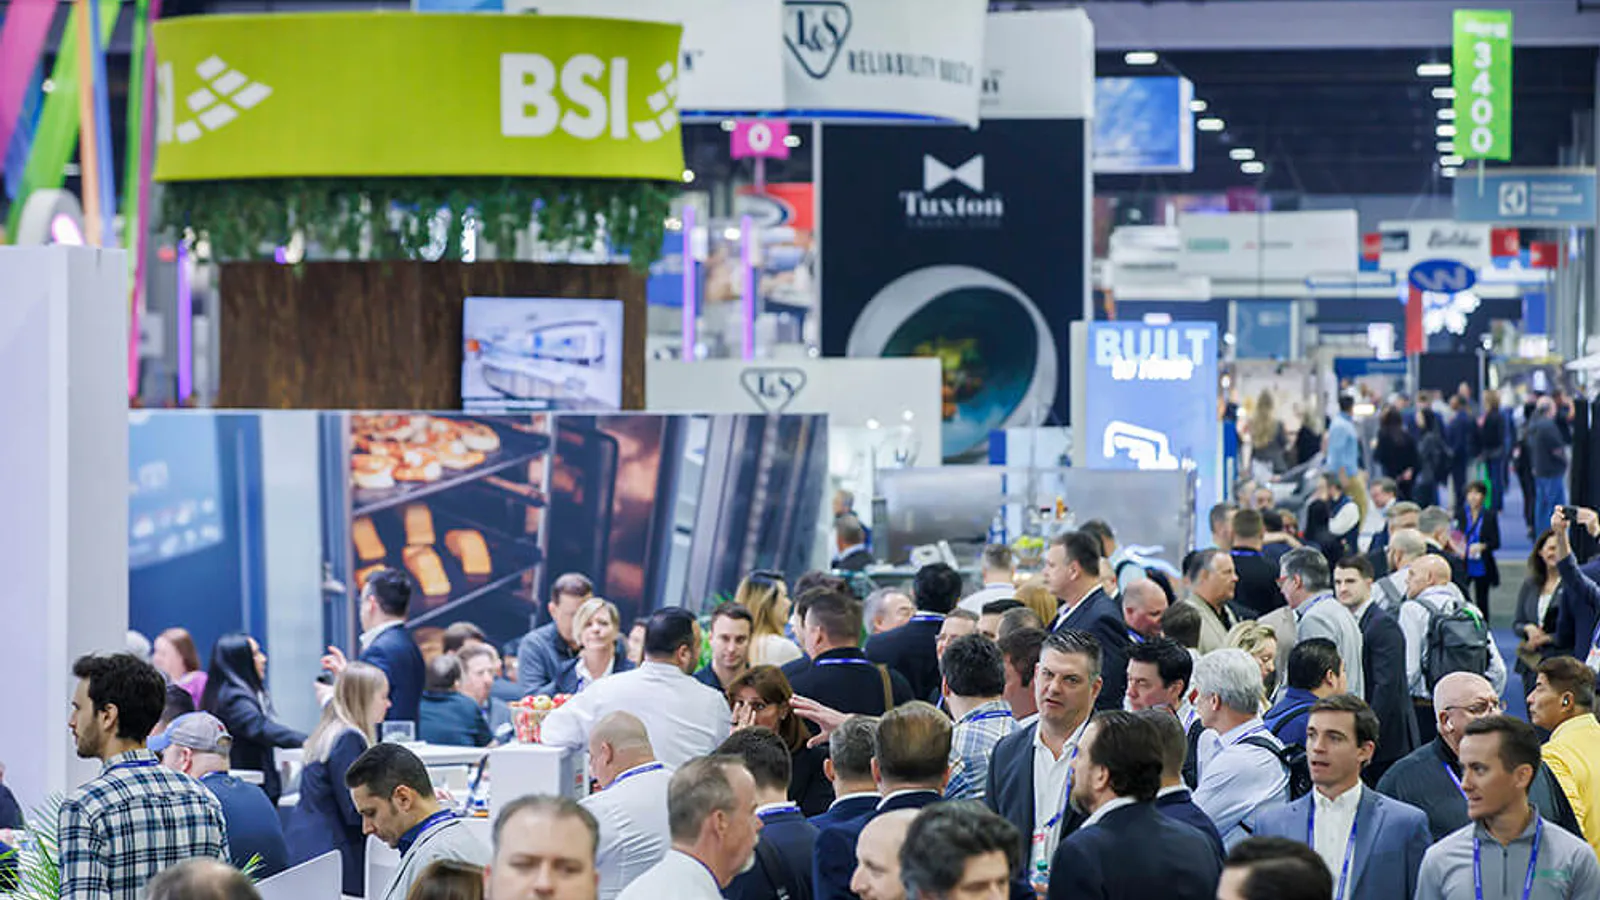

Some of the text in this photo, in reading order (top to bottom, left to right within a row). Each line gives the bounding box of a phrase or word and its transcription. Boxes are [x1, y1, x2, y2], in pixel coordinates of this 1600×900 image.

[500, 53, 629, 140] BSI
[1470, 42, 1494, 154] 3400
[898, 190, 1004, 217] Tuxton
[1096, 328, 1210, 366] BUILT
